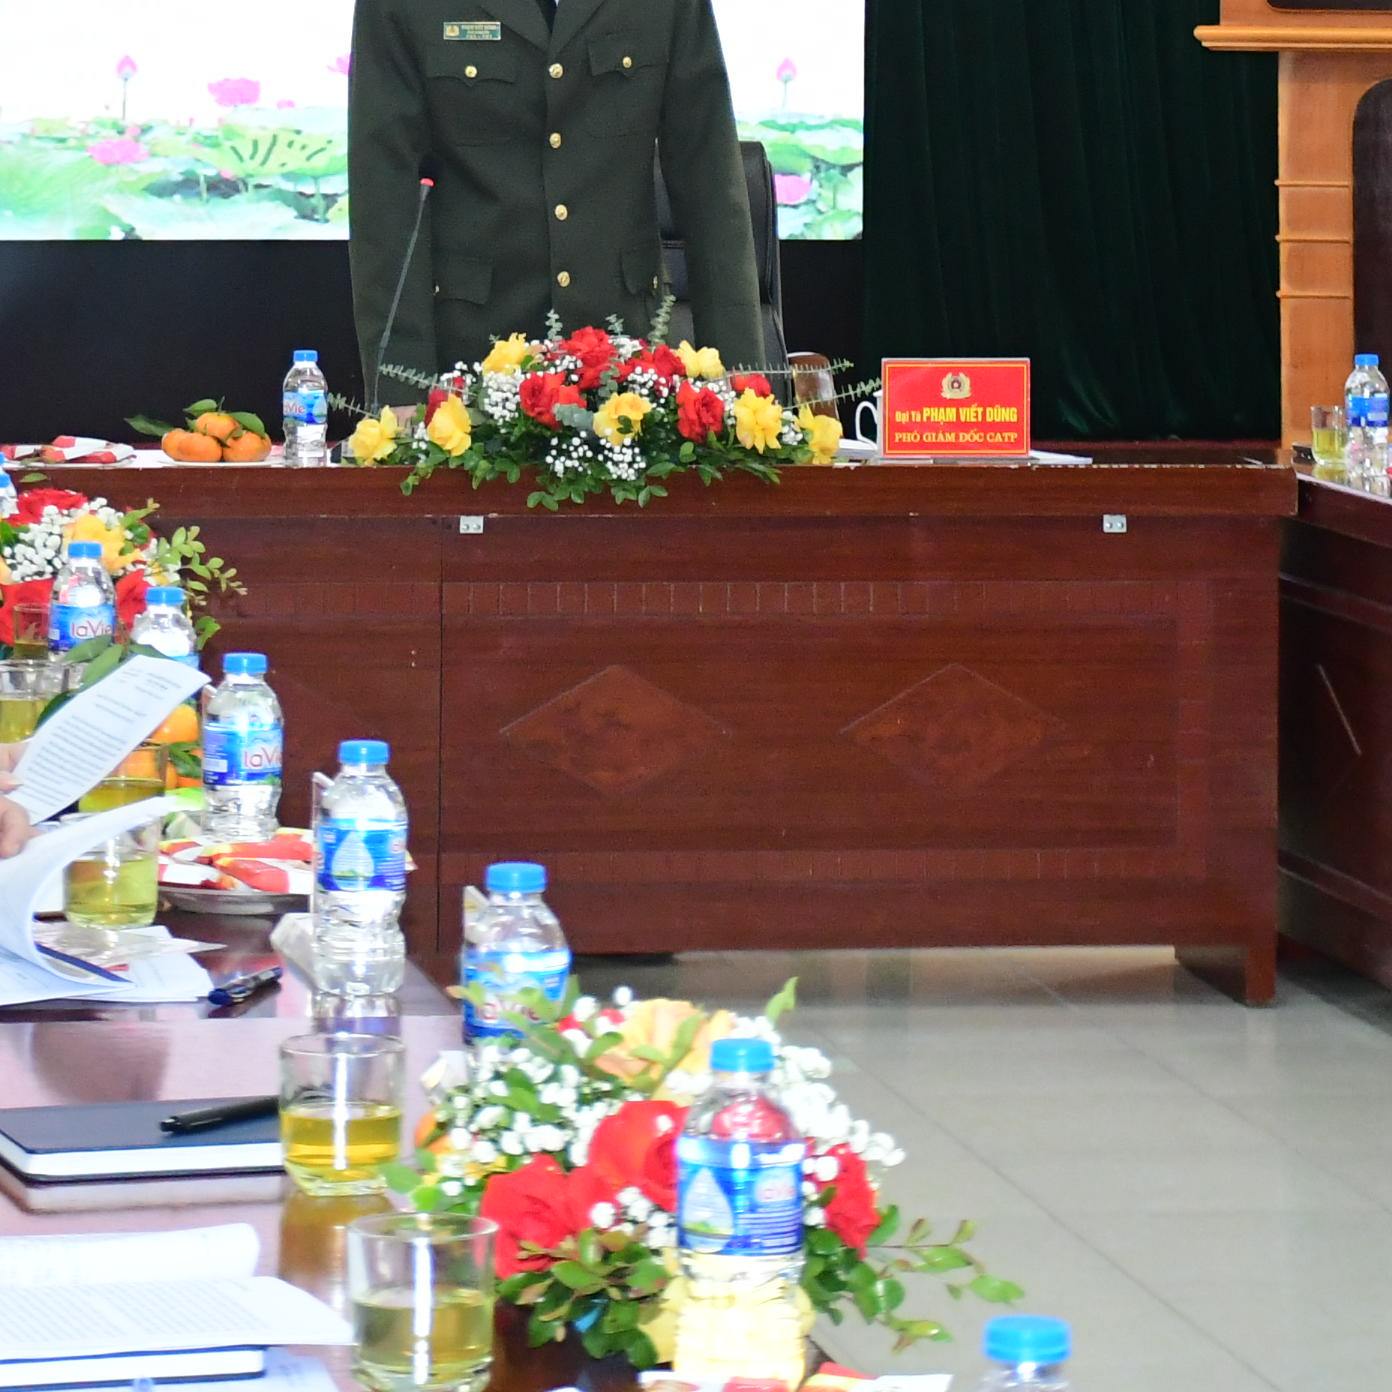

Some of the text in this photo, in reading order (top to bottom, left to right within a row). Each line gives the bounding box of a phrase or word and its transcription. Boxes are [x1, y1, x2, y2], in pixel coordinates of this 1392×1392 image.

[923, 407, 957, 425] PHẠM
[959, 403, 984, 423] VIẾT
[986, 404, 1018, 423] DŨNG
[894, 428, 921, 443] PHÓ
[922, 428, 957, 443] GIÁM
